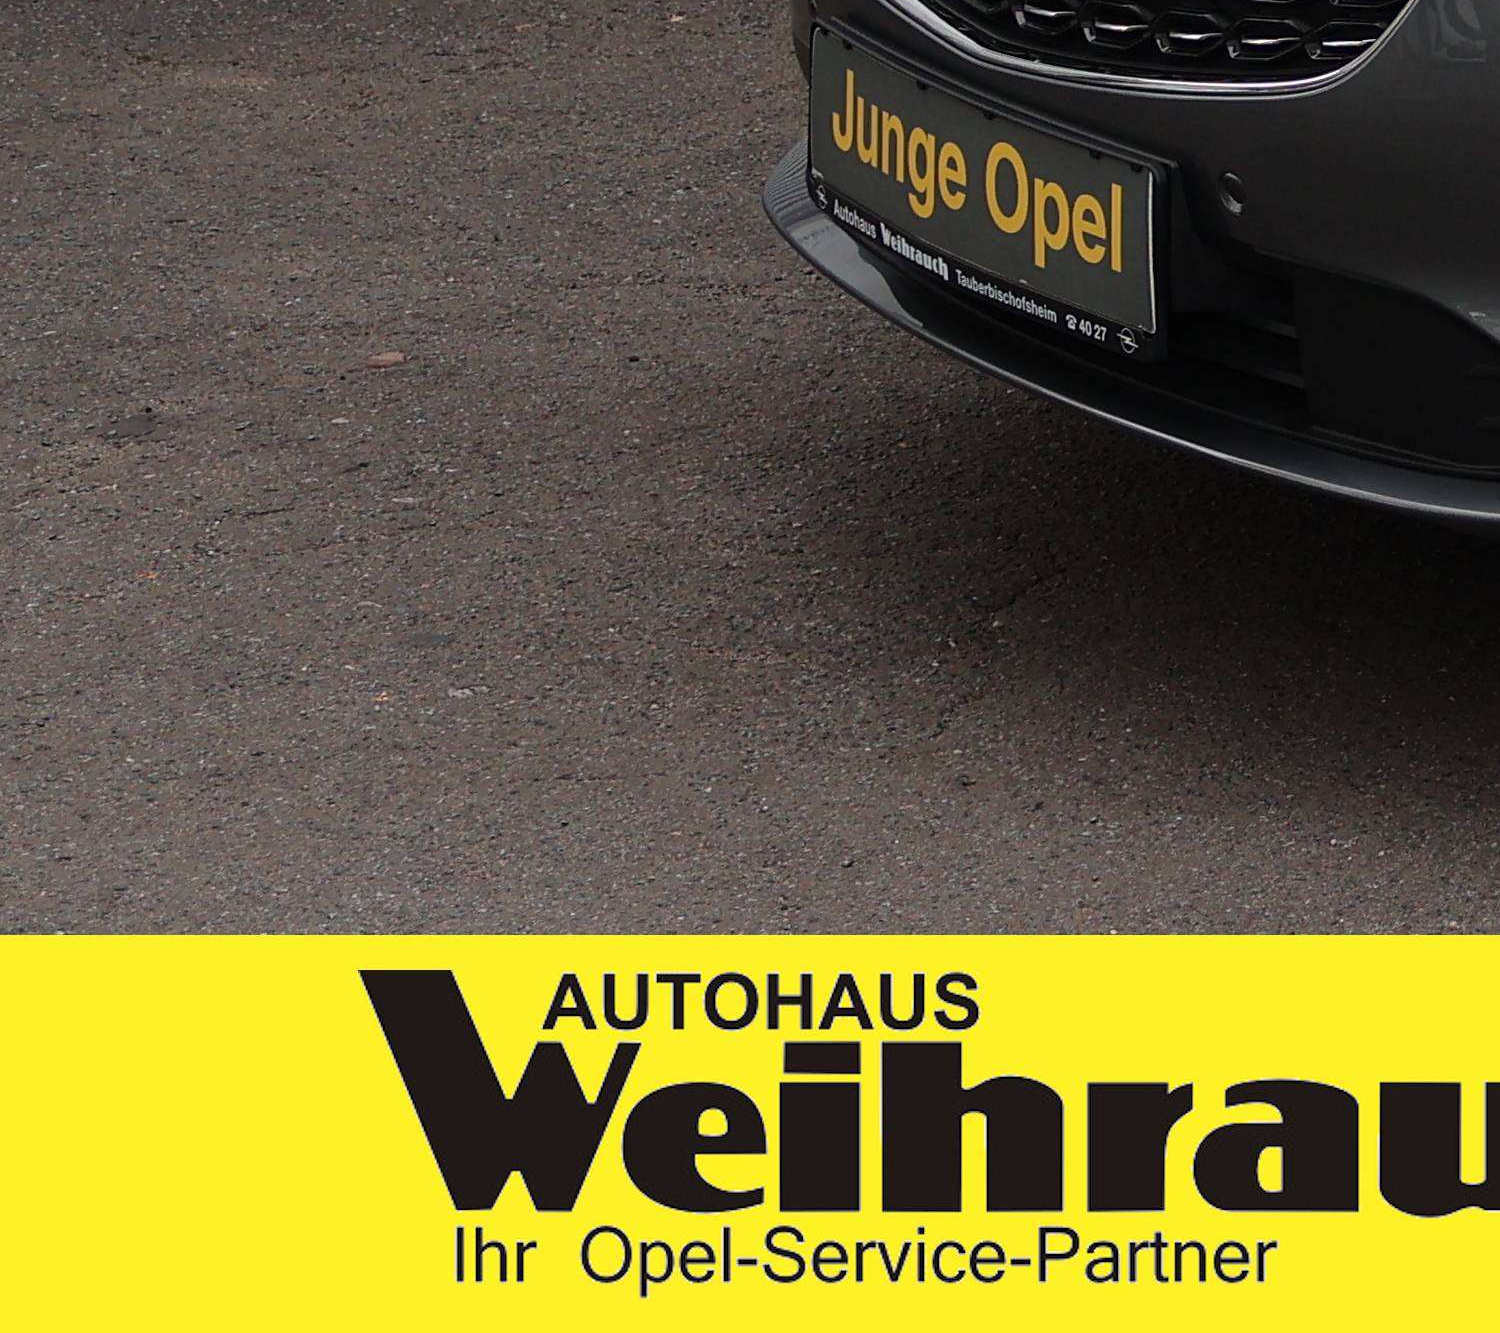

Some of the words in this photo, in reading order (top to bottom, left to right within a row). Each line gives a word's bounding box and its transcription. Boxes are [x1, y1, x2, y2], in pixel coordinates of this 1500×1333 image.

[832, 68, 967, 219] Junge
[985, 141, 1122, 273] Opel
[834, 198, 876, 239] Autohaus
[880, 222, 949, 281] Weihrauch
[956, 269, 1057, 323] Tauberbischofsheim
[1079, 319, 1092, 337] 40
[1093, 323, 1107, 342] 27
